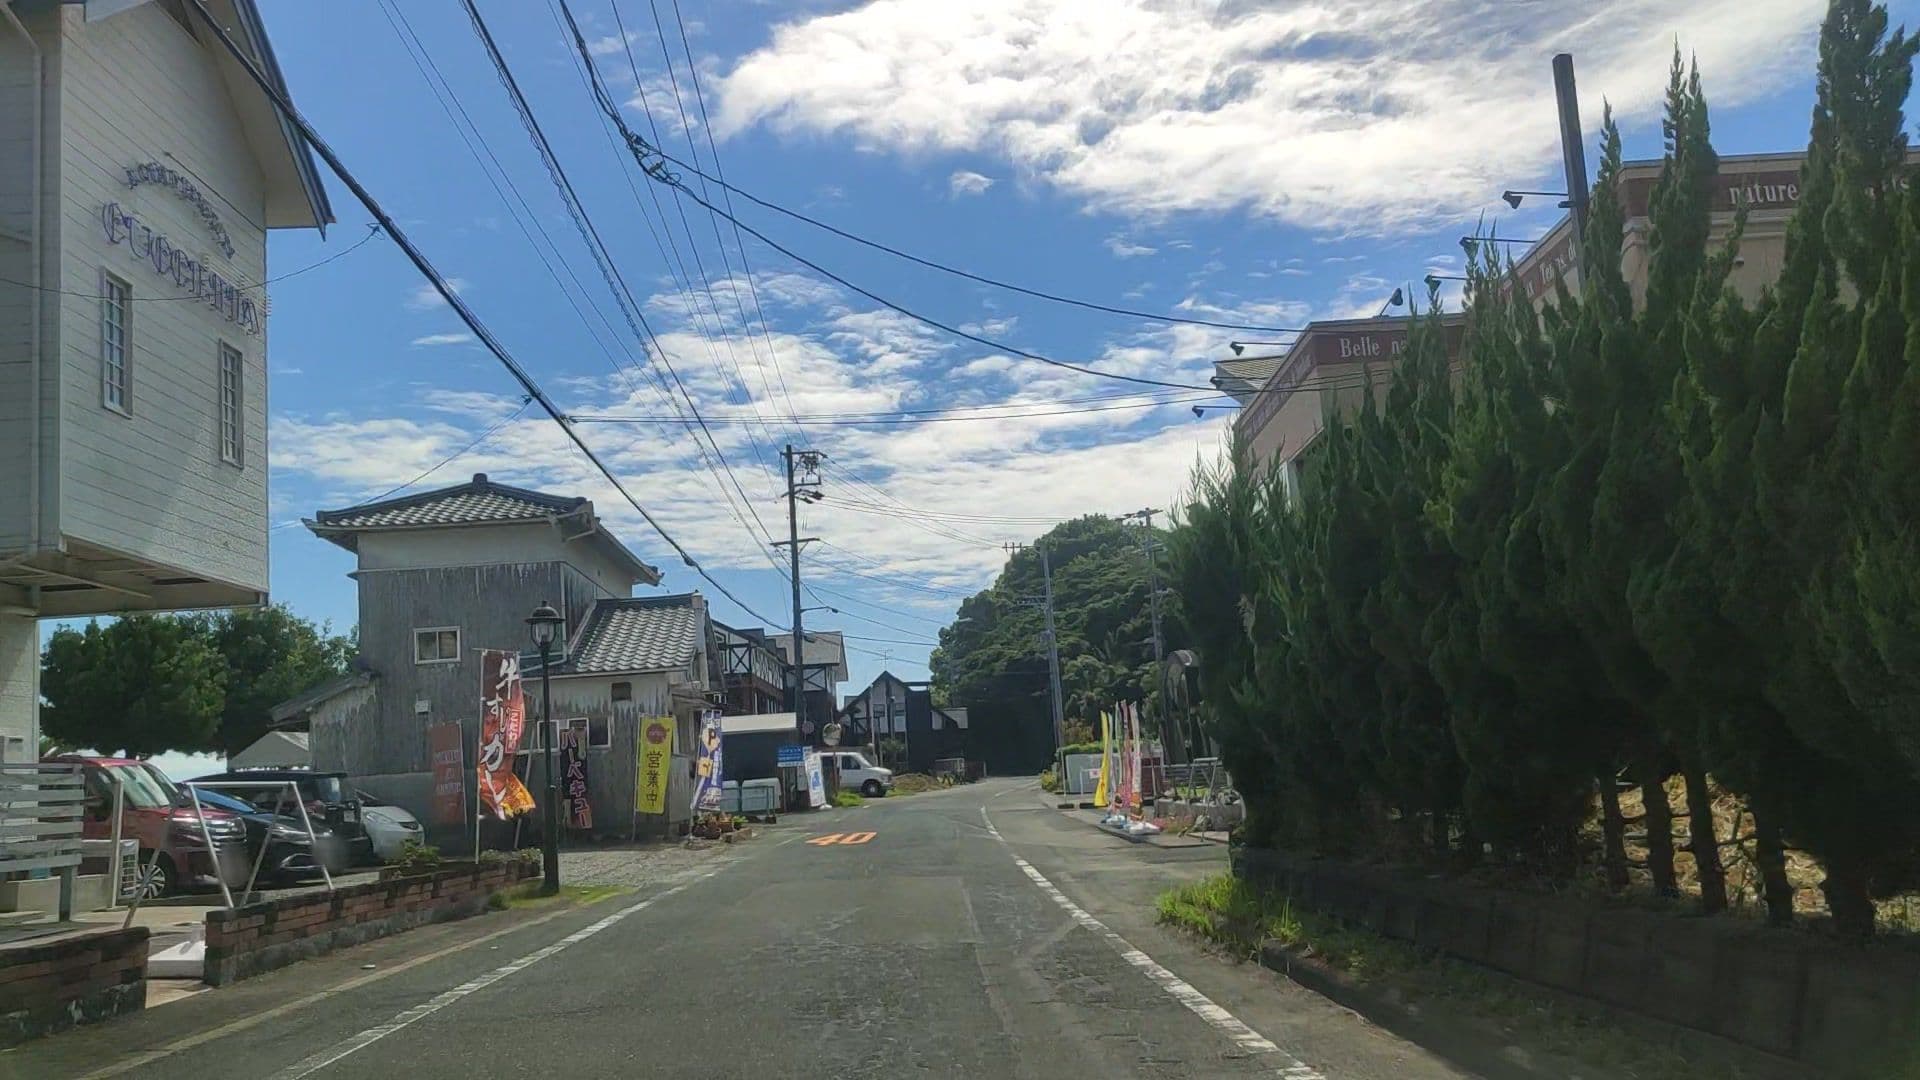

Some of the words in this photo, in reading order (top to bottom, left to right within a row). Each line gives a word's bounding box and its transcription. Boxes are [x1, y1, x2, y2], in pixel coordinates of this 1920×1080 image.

[1339, 336, 1380, 358] Belle
[646, 749, 663, 806] 営業中
